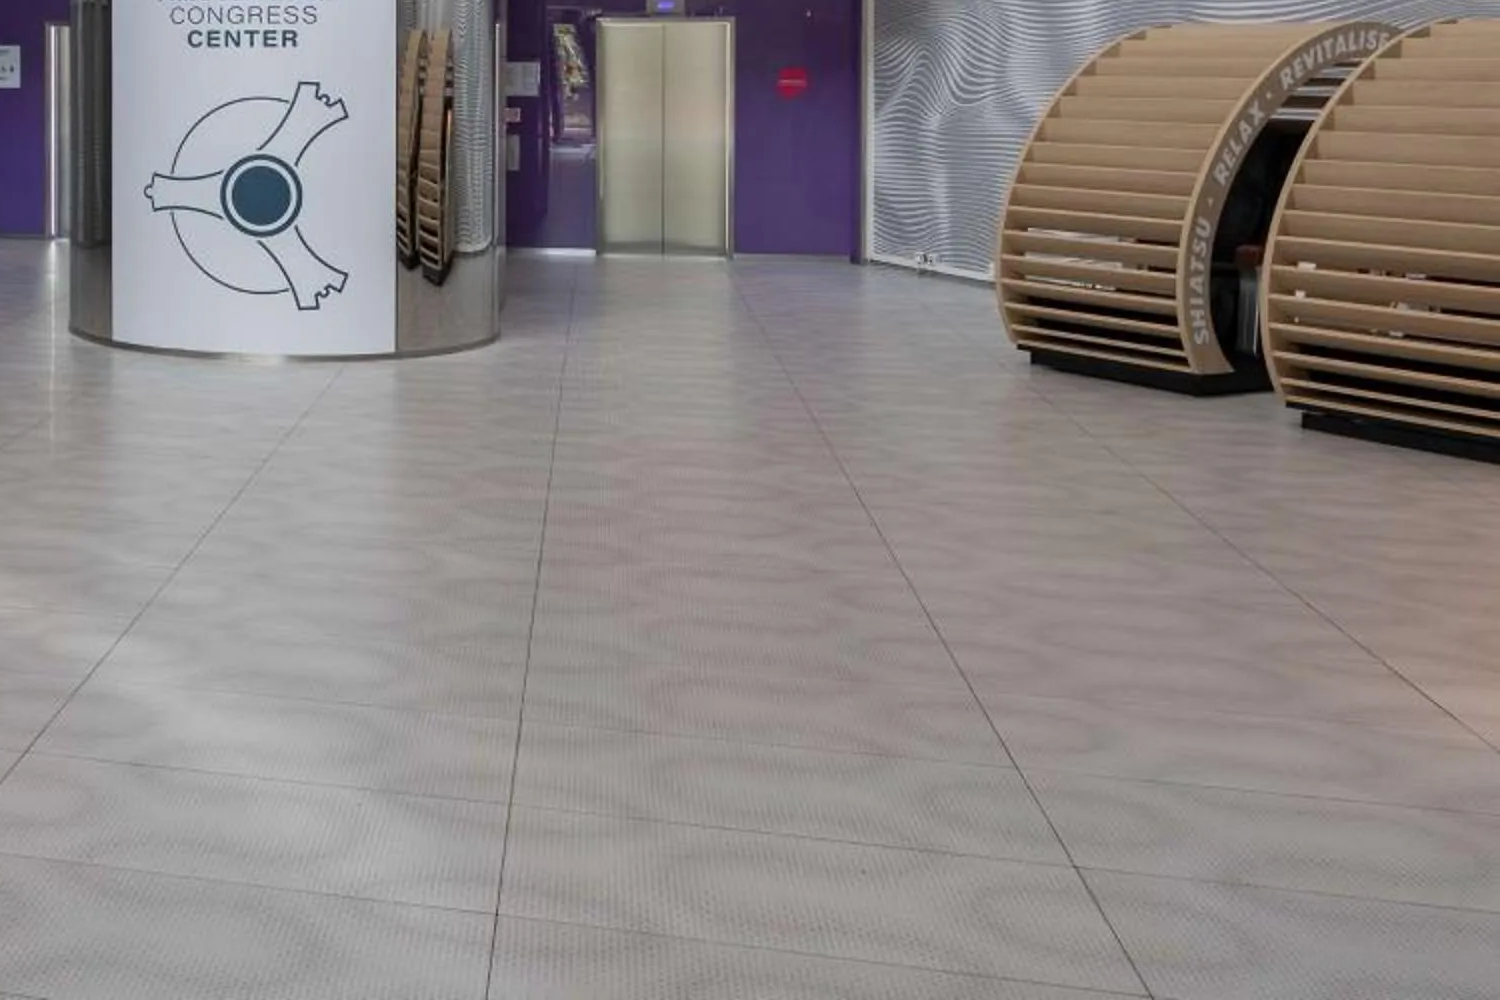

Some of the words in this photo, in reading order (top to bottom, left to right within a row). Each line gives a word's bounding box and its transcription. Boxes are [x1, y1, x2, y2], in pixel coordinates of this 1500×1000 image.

[170, 4, 319, 25] CONGRESS
[186, 29, 299, 49] CENTER
[1189, 215, 1212, 346] SHIATSU
[1213, 100, 1266, 187] RELAX
